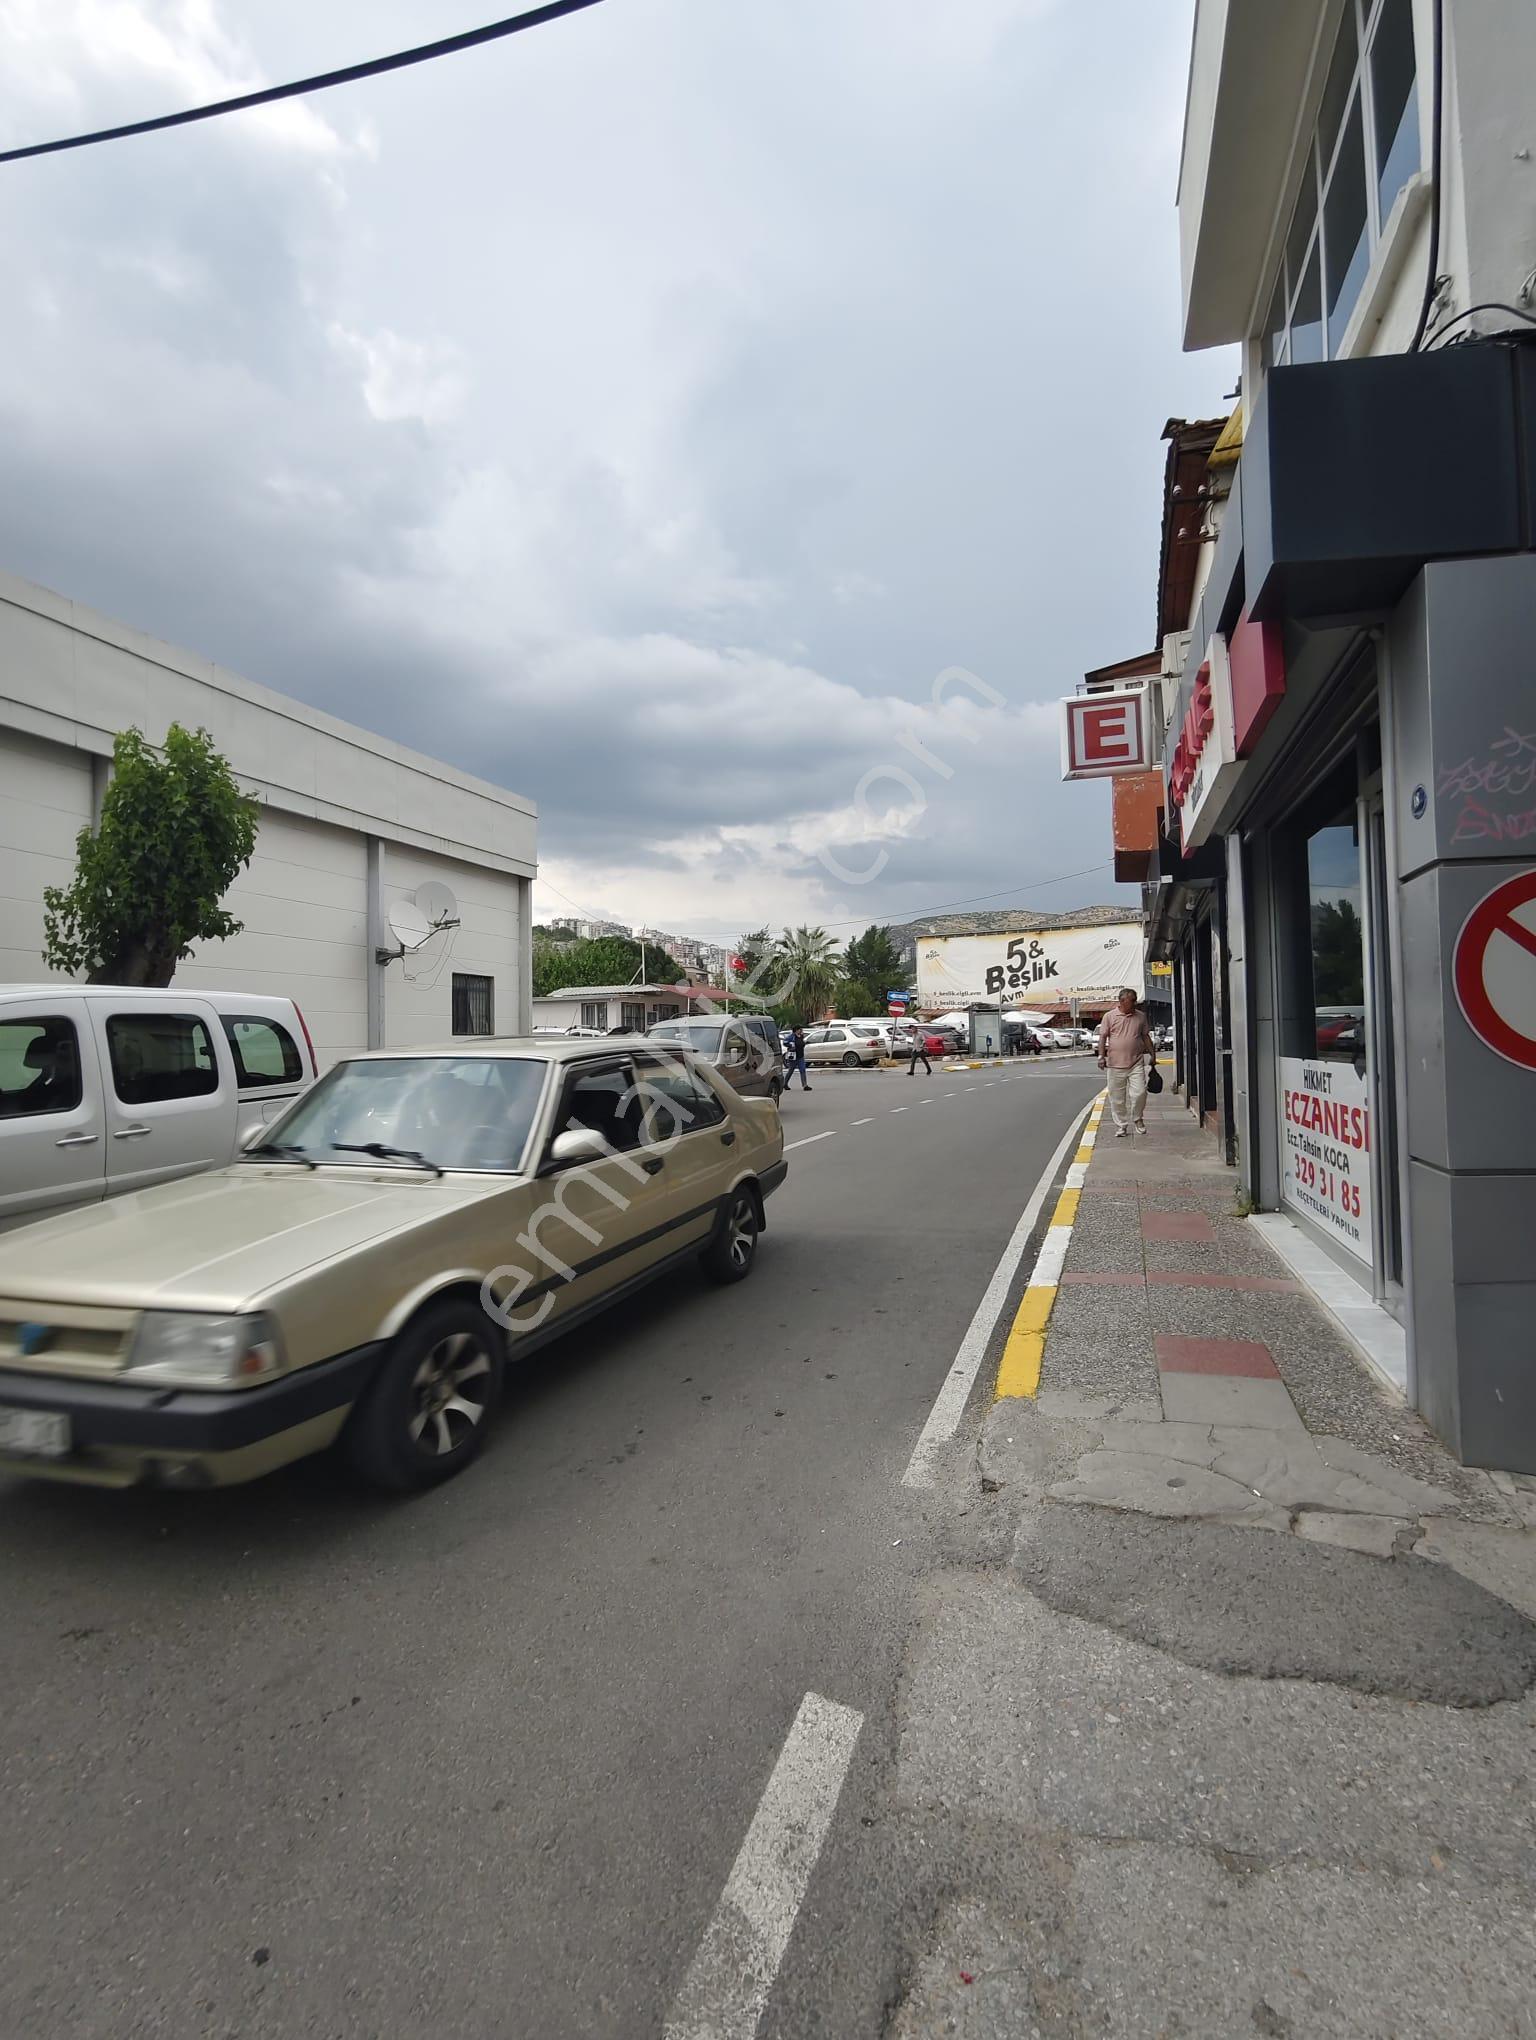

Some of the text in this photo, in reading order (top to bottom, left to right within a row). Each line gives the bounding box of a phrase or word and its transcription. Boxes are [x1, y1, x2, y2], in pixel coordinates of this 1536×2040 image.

[1083, 707, 1129, 760] E
[985, 959, 1060, 995] Beşlik
[1001, 990, 1024, 1004] Avm
[1303, 1064, 1332, 1094] HİKMET
[1284, 1090, 1370, 1153] ECZANESİ
[1323, 1144, 1350, 1174] KOCA
[1294, 1153, 1361, 1218] 329 31 85
[1331, 1211, 1361, 1241] YAPILIR
